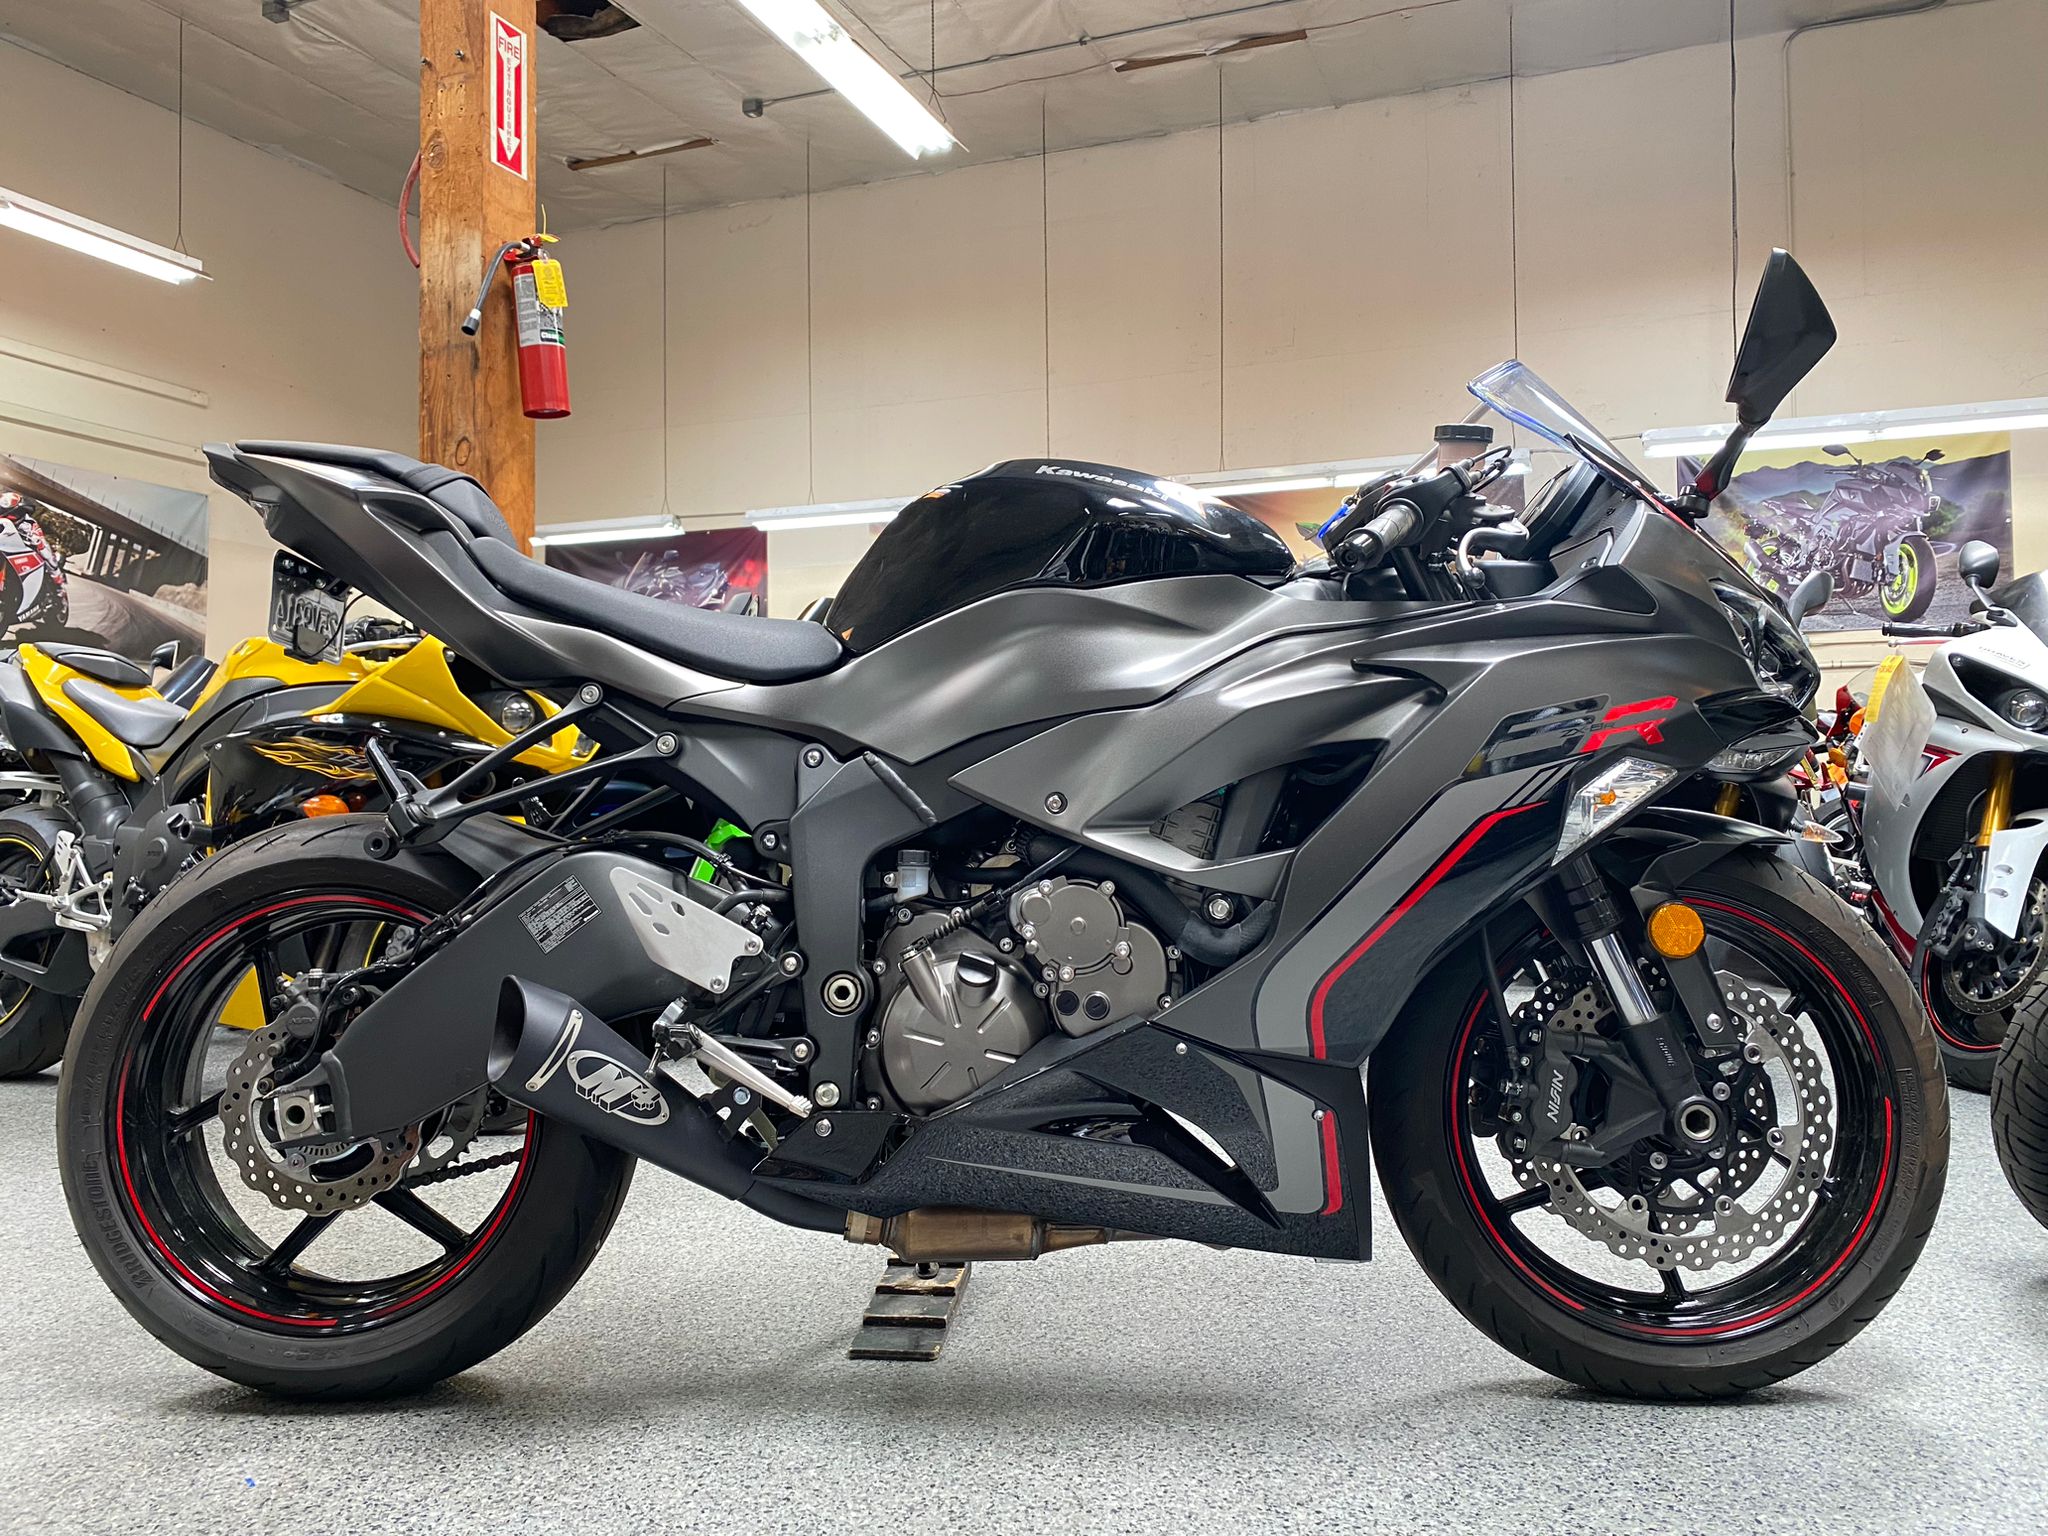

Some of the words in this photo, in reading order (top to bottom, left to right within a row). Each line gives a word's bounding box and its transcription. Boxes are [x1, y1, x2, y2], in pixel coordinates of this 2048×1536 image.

[499, 36, 521, 60] FIRE
[1035, 464, 1169, 501] Kawasaki
[1546, 1069, 1565, 1123] NISSIN
[82, 1155, 155, 1288] BRIDGESTONE
